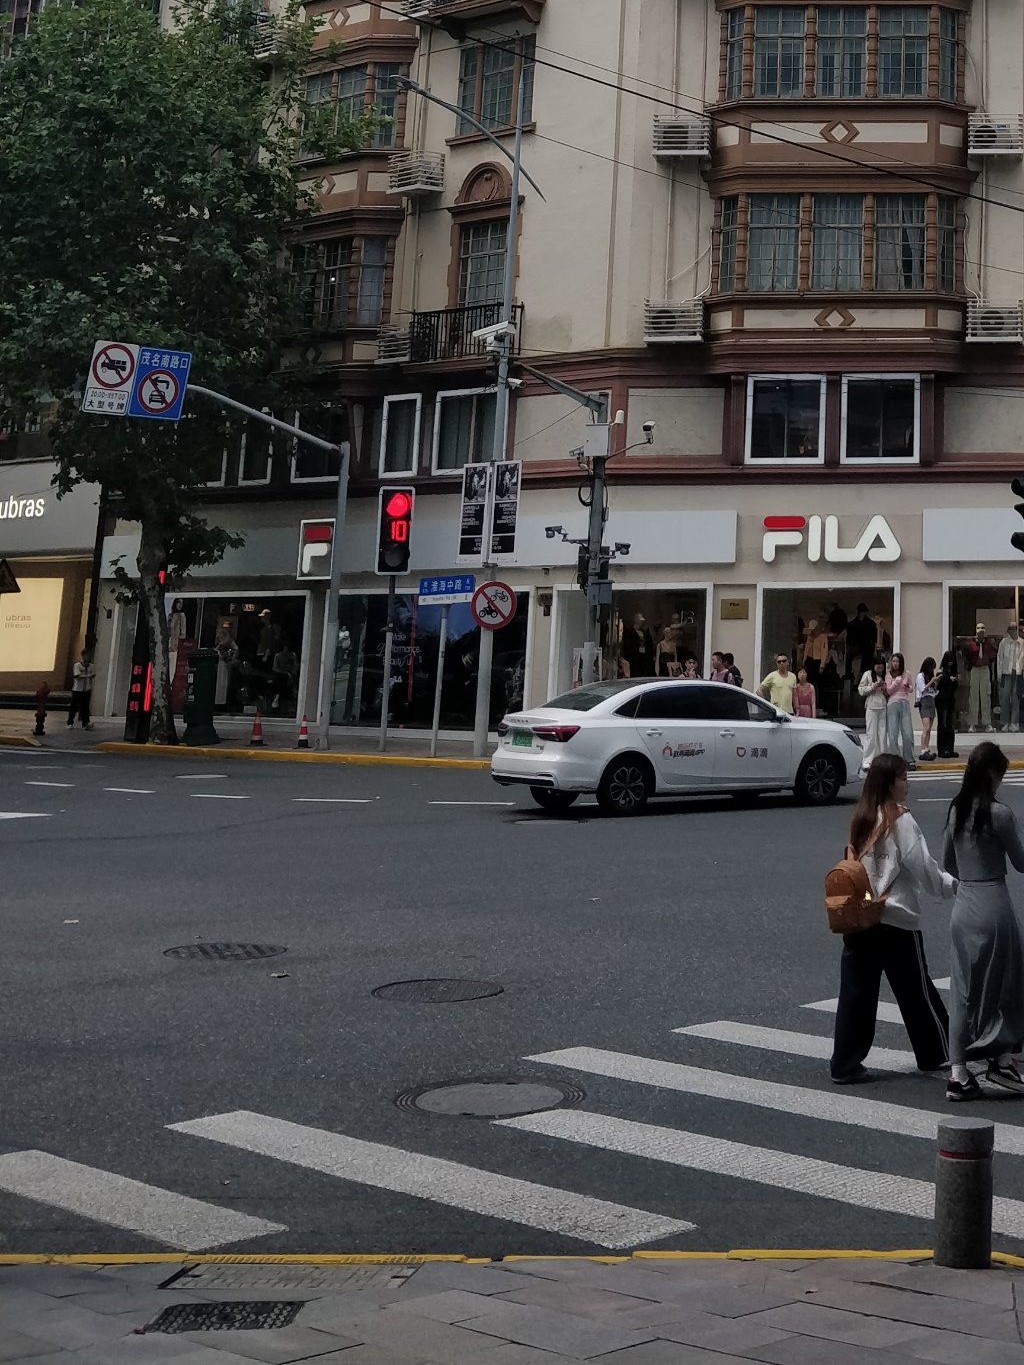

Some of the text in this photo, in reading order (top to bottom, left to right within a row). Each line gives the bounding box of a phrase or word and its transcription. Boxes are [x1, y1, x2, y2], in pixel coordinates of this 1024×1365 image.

[140, 351, 189, 369] 茂名南路口
[0, 495, 45, 519] ubras
[391, 520, 407, 542] 10
[762, 514, 902, 563] FILA
